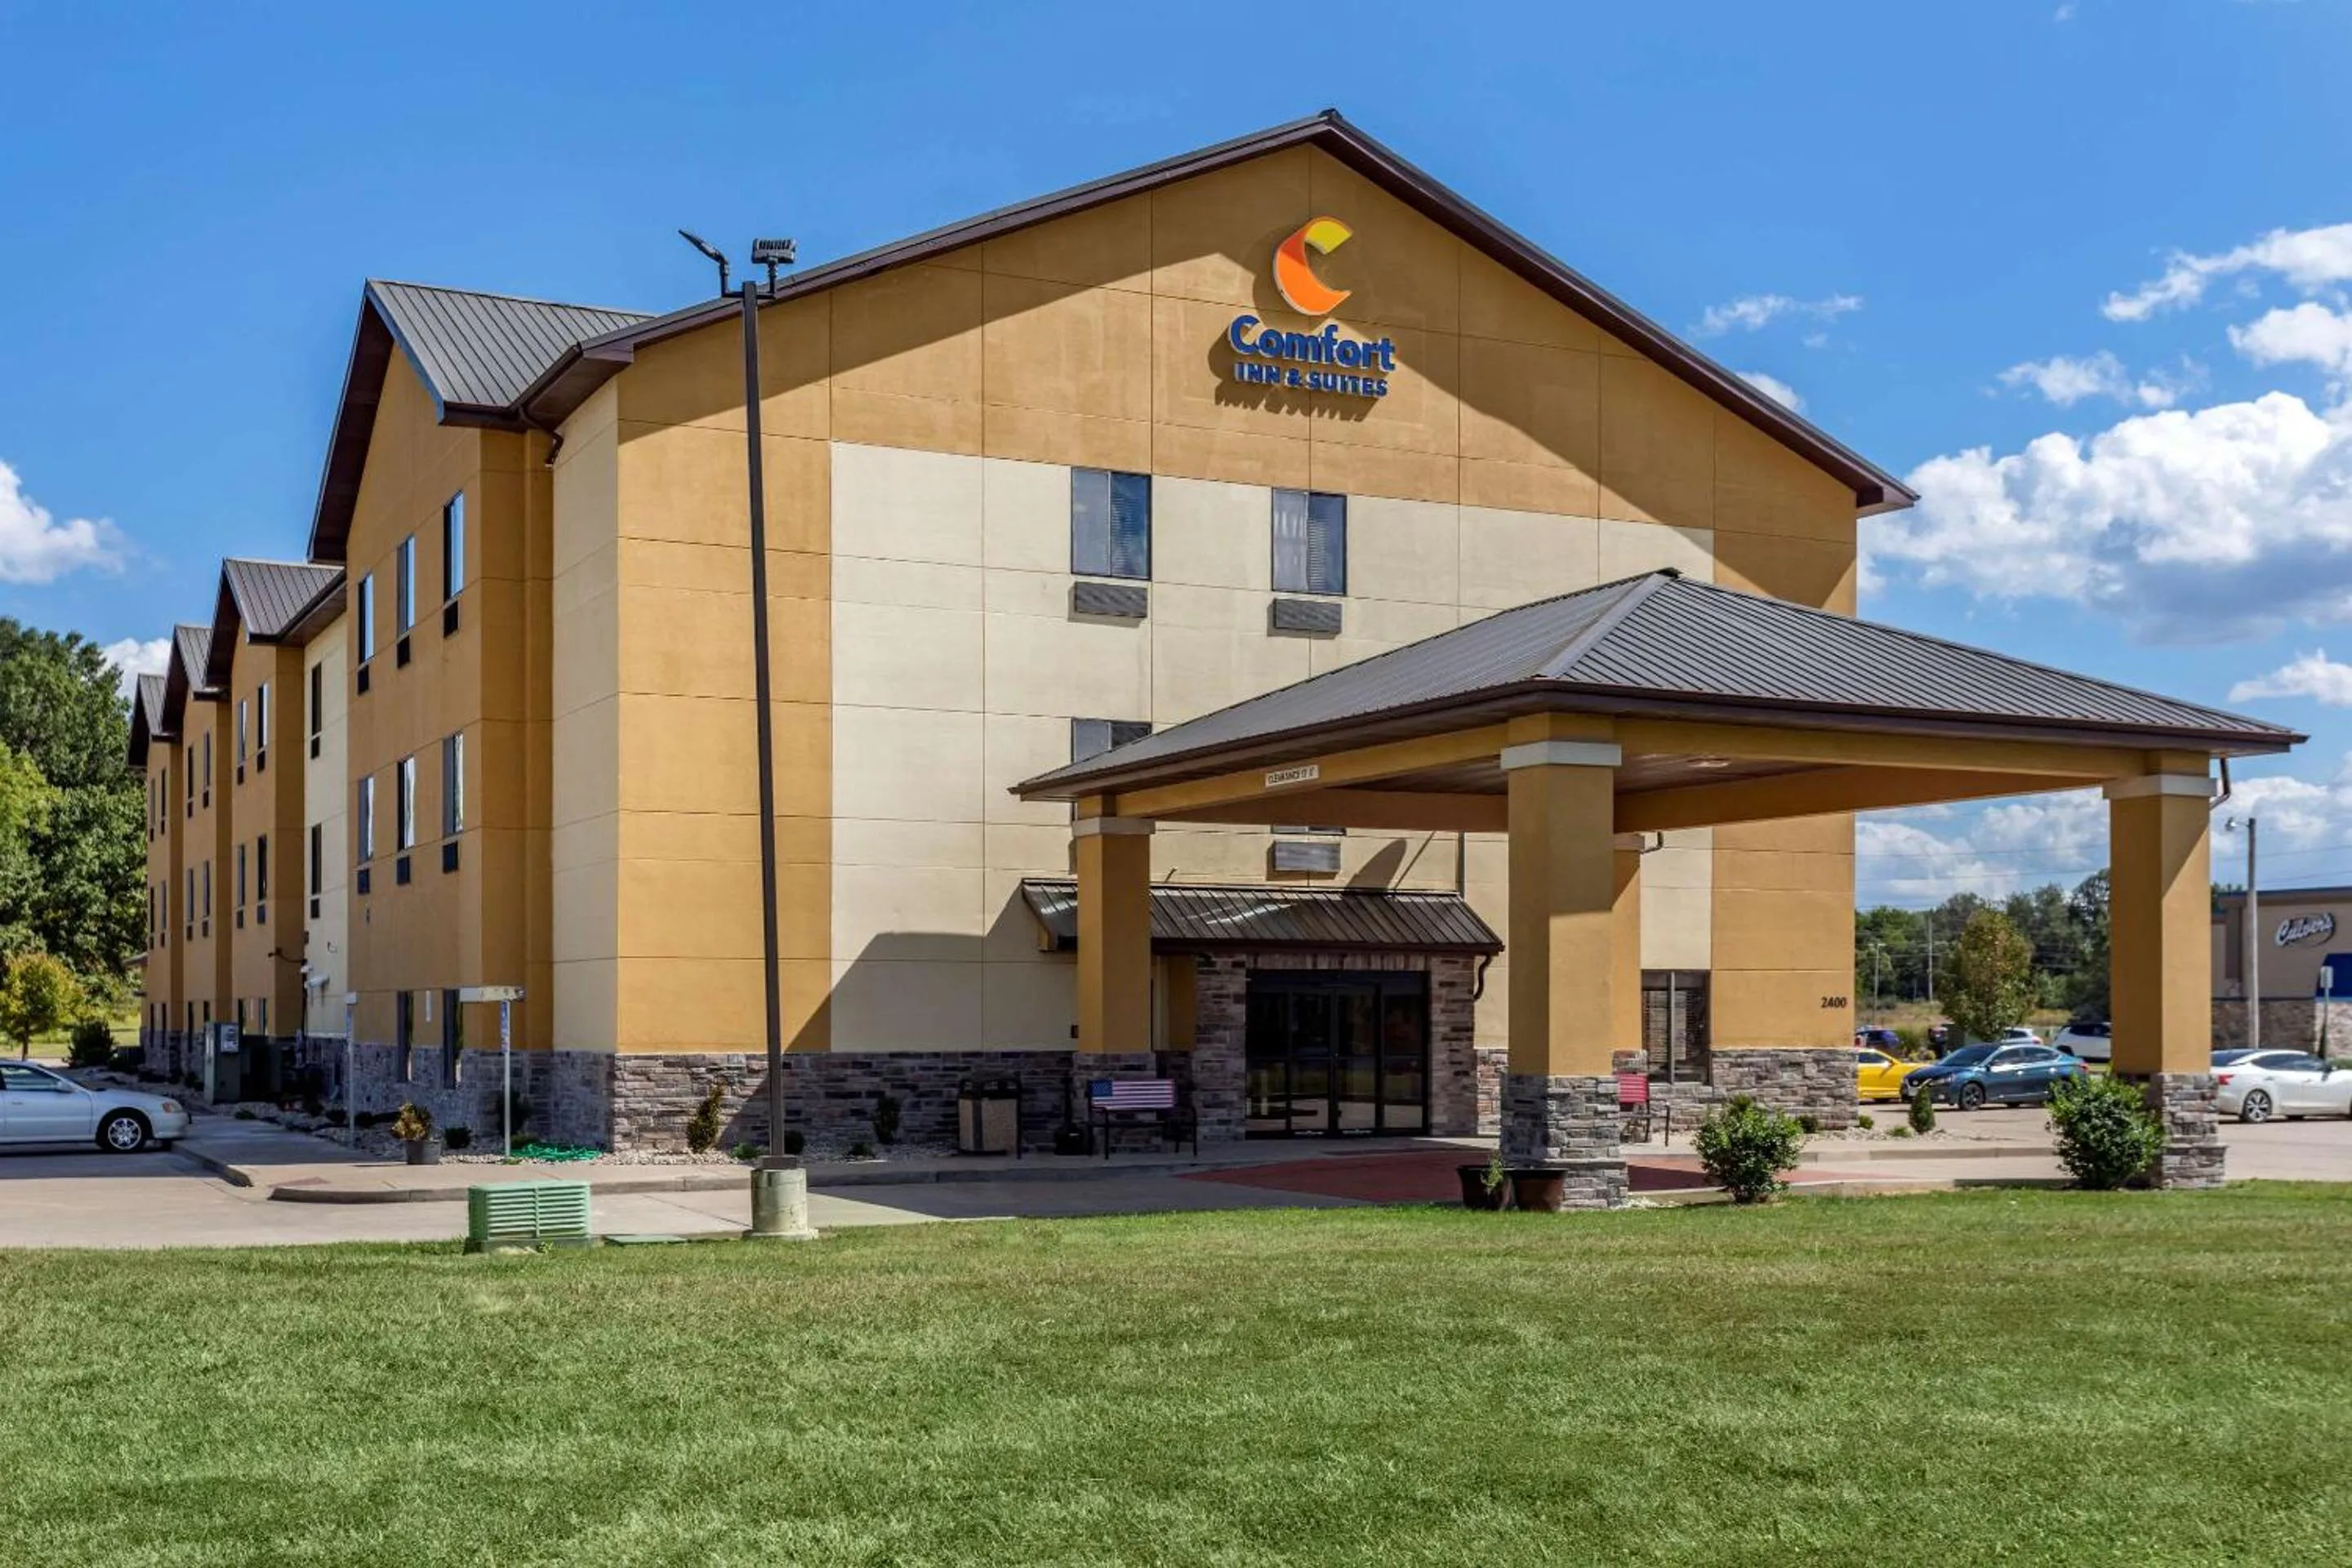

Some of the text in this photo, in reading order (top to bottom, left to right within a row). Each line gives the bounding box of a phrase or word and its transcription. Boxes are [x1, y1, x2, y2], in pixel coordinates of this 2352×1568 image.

[1229, 314, 1396, 372] Comfort
[1234, 362, 1388, 398] INN & SUITES
[1820, 996, 1847, 1009] 2400
